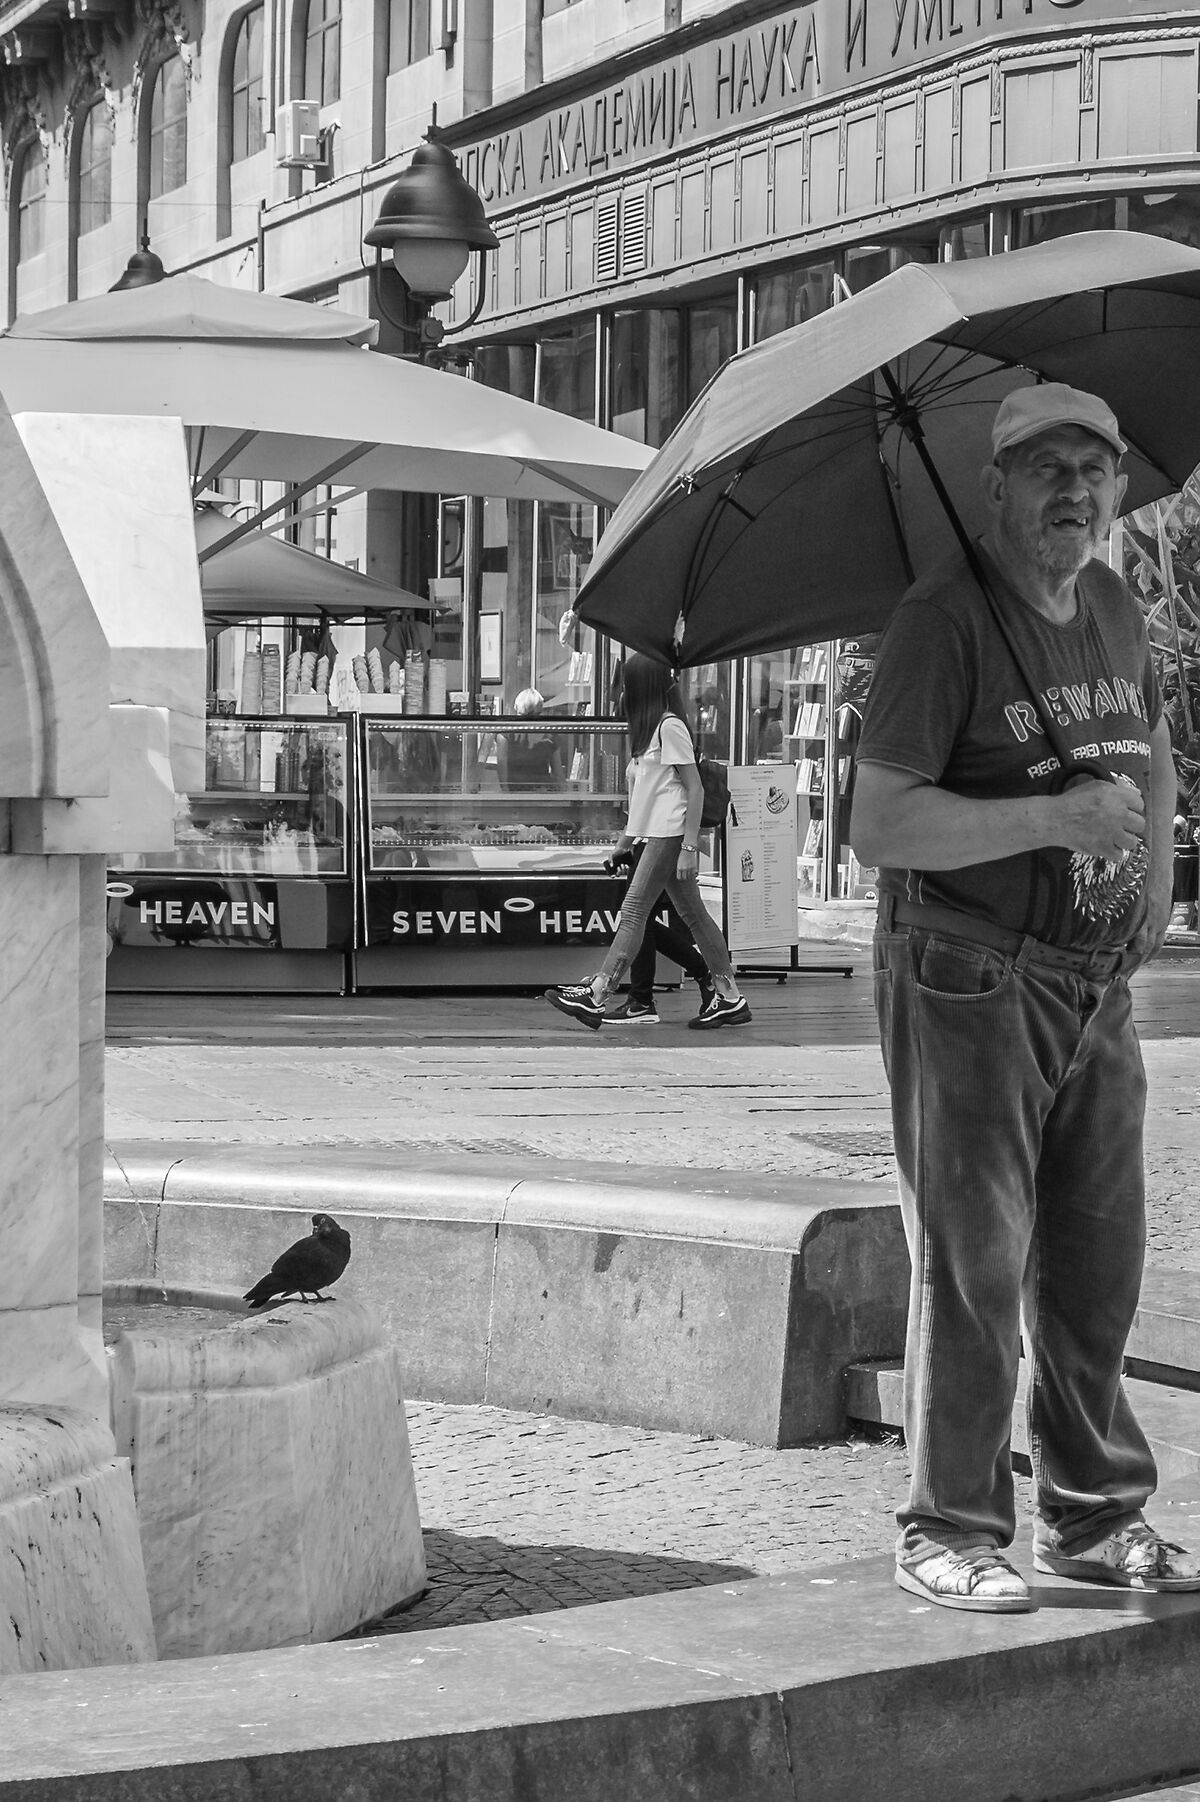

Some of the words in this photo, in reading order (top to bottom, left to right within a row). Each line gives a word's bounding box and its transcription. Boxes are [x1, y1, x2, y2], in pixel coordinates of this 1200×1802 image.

[455, 128, 526, 202] ПСКА
[538, 60, 697, 183] АКАДЕМИЈА
[716, 11, 821, 119] НАУКА
[1027, 743, 1100, 780] REGIERED
[1101, 739, 1151, 759] TRADEMAR
[140, 901, 275, 925] HEAVEN
[392, 910, 501, 934] SEVEN
